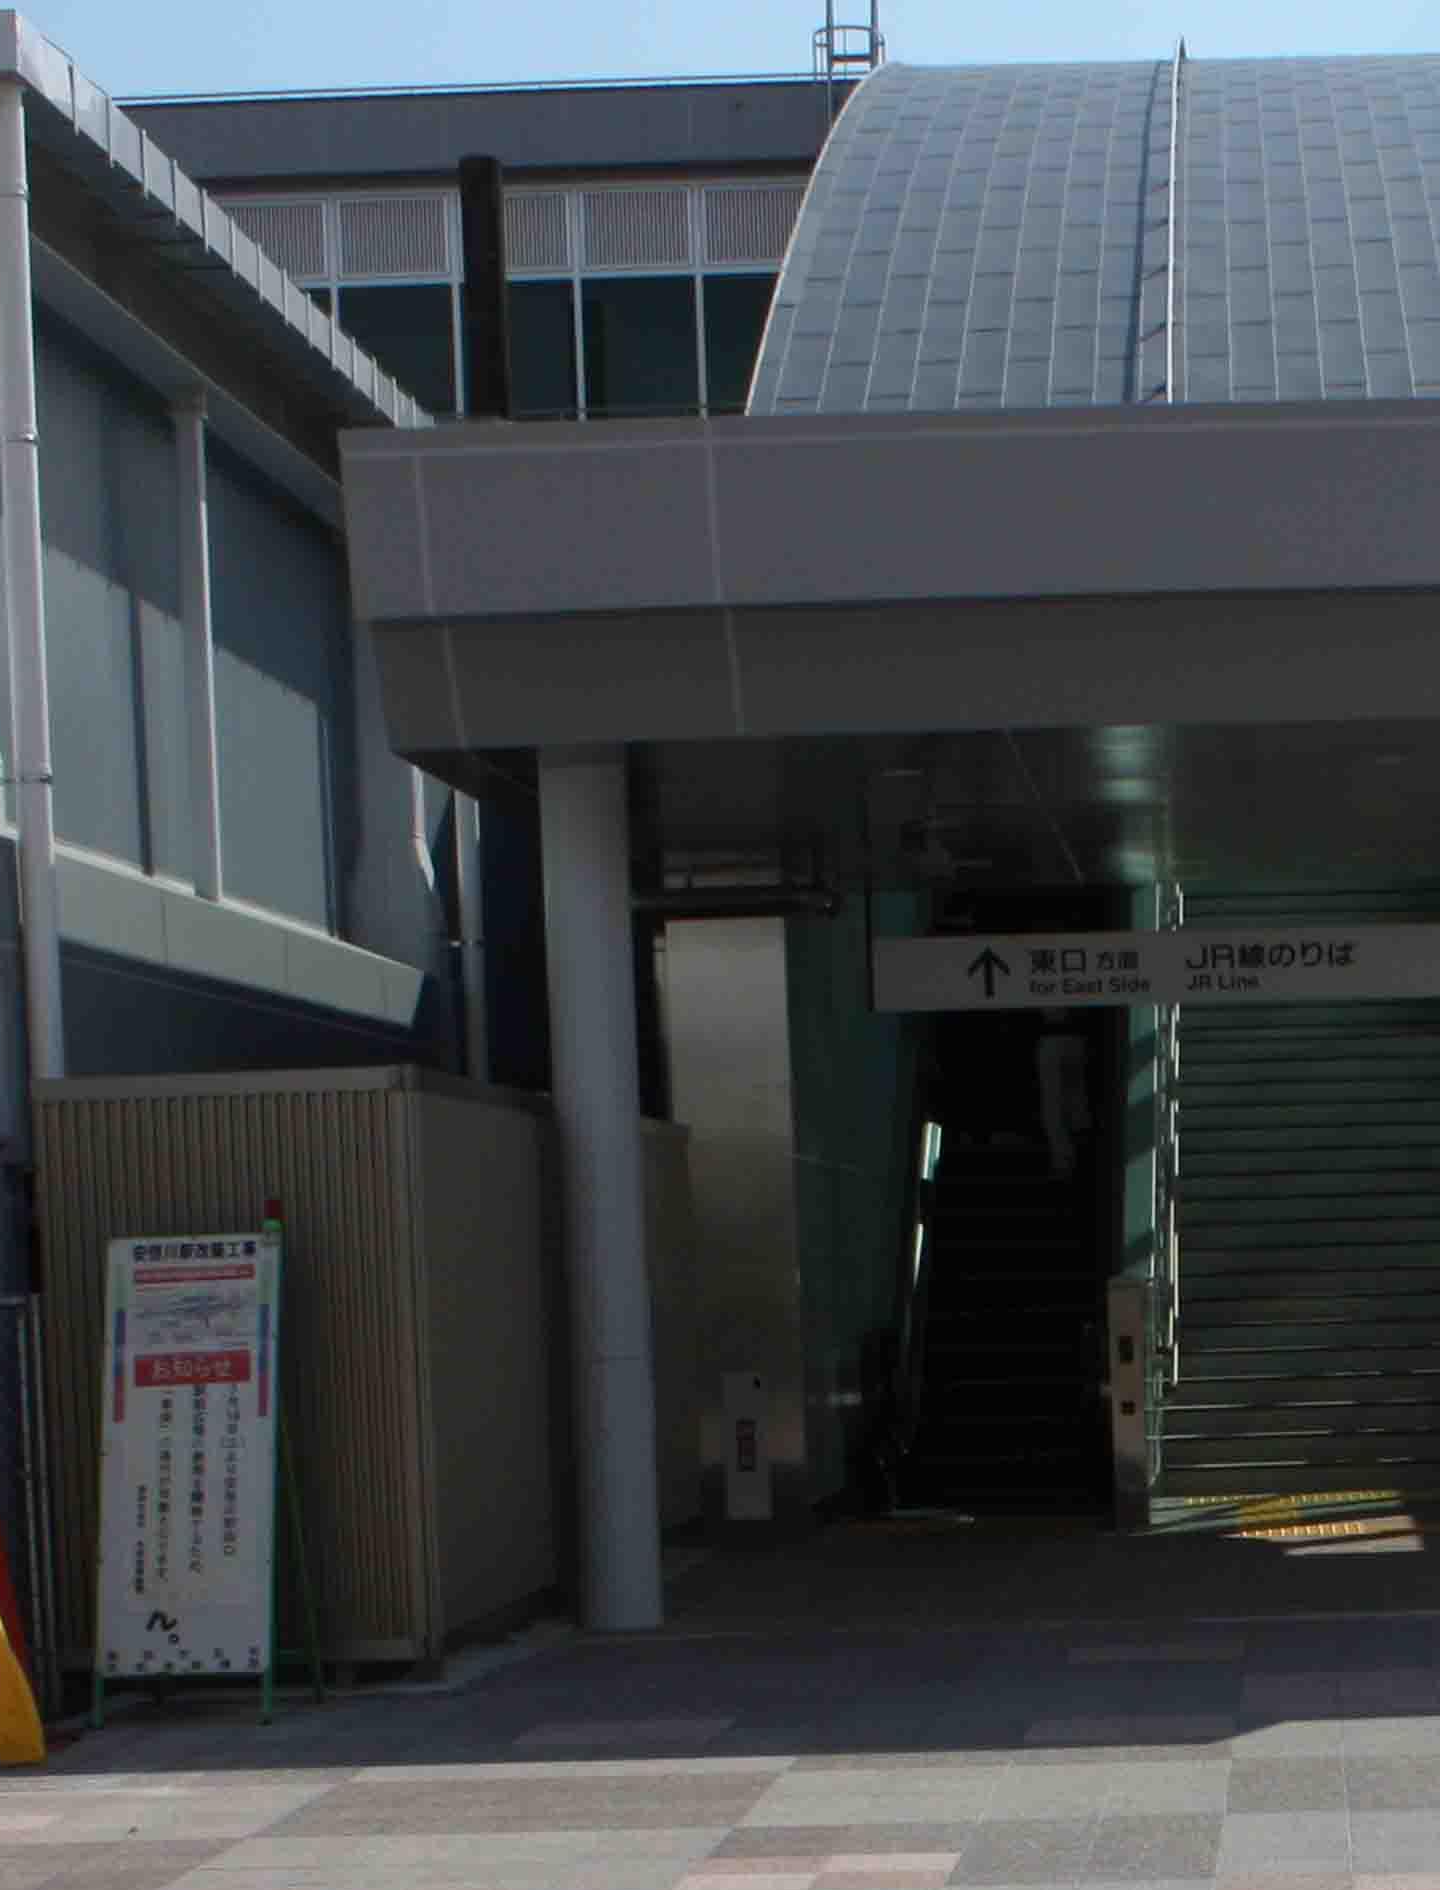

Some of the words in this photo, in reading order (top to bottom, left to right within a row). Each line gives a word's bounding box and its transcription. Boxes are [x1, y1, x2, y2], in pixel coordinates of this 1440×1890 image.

[1186, 941, 1356, 970] JR線のりば
[1029, 977, 1056, 993] for
[1063, 977, 1103, 994] East
[1109, 976, 1151, 992] Side
[1187, 975, 1211, 991] JR
[1217, 975, 1259, 990] Line
[151, 1357, 233, 1380] お知らせ
